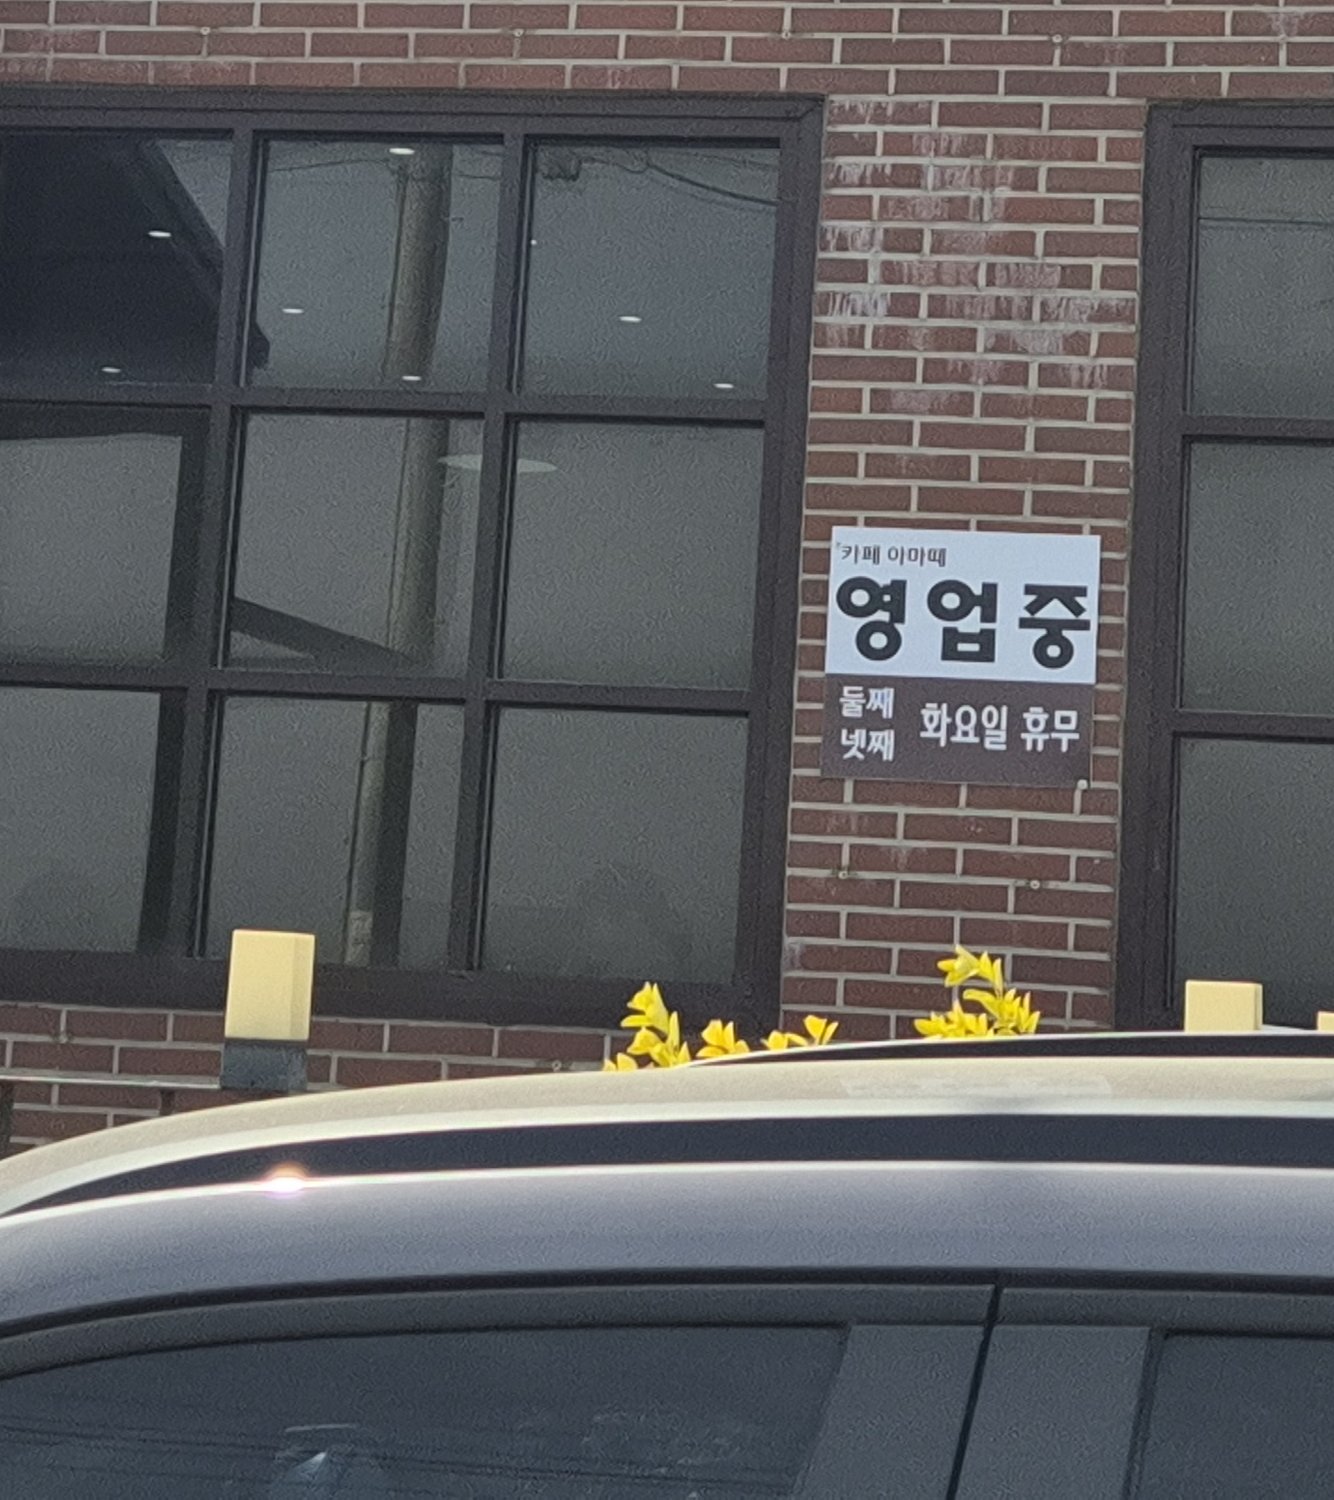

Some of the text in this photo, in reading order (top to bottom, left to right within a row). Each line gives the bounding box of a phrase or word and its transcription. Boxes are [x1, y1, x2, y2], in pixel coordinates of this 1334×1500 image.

[840, 544, 880, 565] 카페
[836, 576, 1091, 669] 영업중
[839, 686, 895, 719] 둘째
[920, 702, 1080, 753] 화요일 휴무
[840, 728, 895, 762] 넷째
